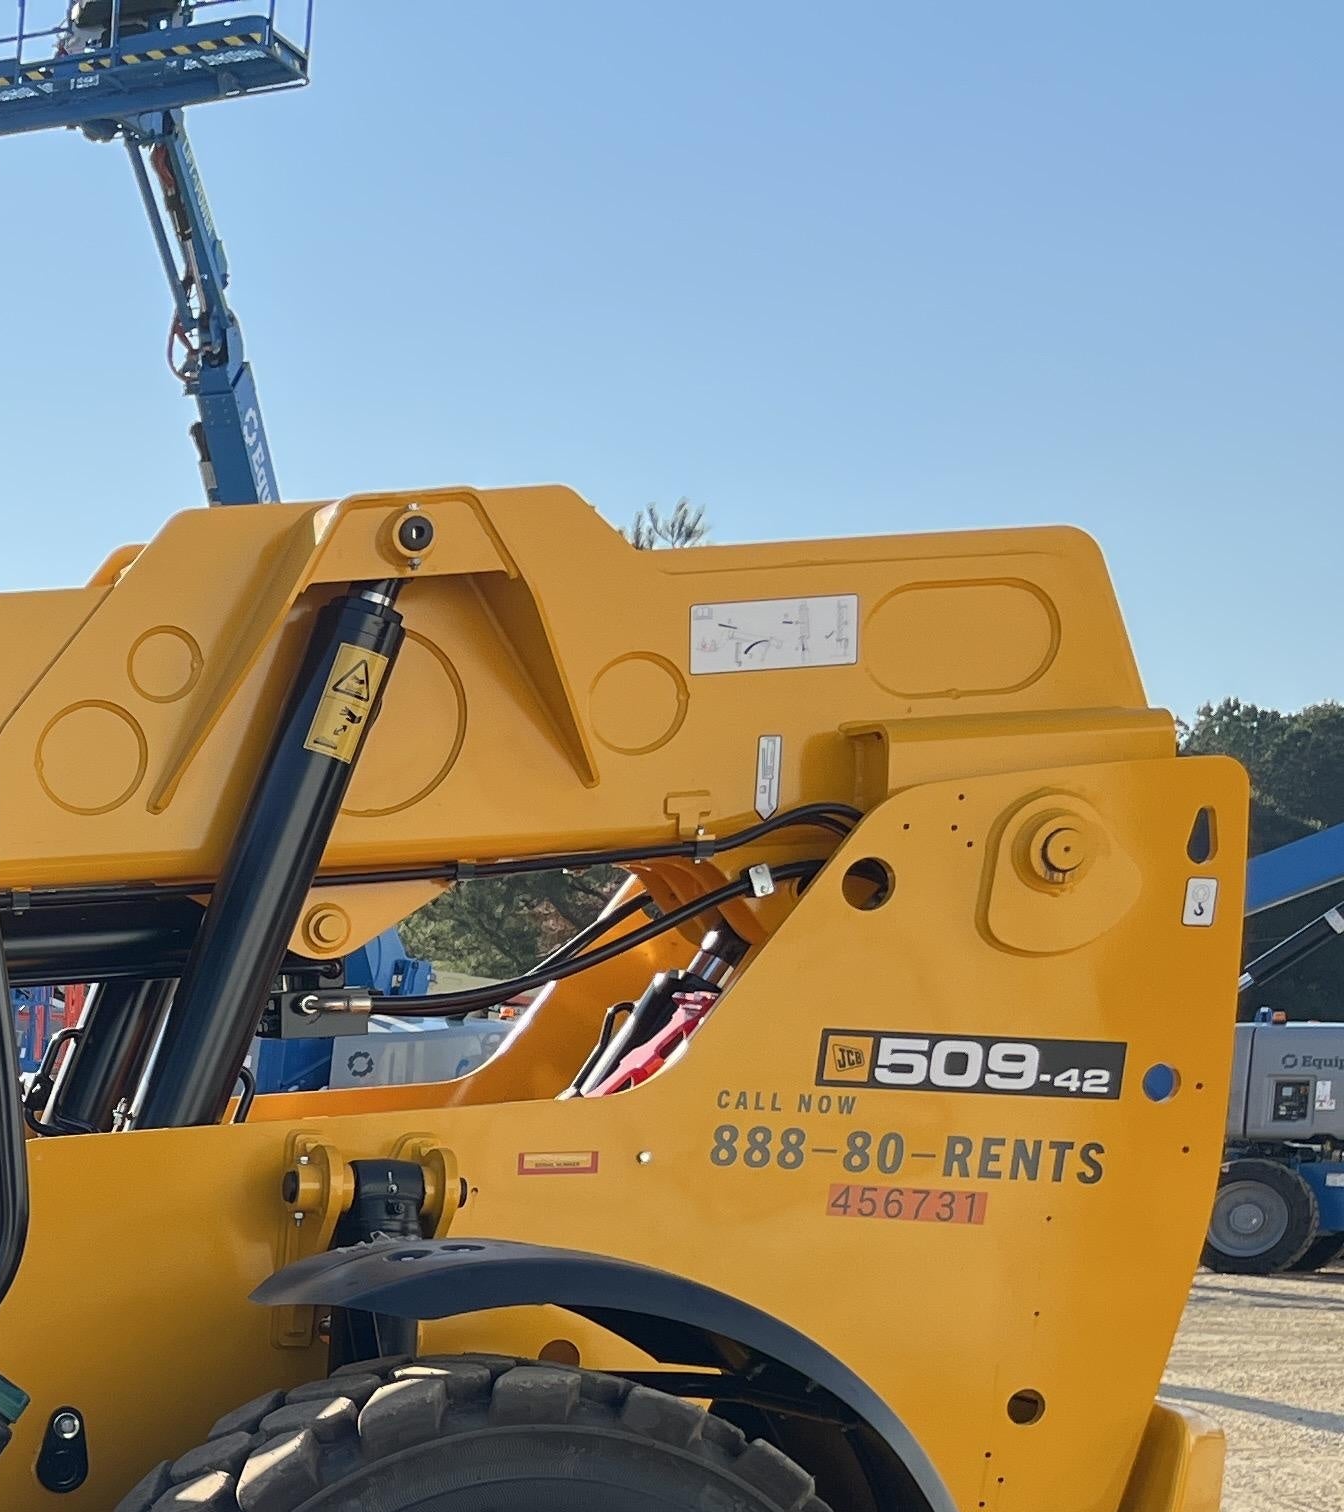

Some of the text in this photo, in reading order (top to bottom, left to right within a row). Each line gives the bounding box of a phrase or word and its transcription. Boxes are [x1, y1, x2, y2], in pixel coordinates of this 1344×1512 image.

[836, 1047, 863, 1069] JCB
[874, 1037, 1111, 1094] 509-42
[716, 1089, 857, 1116] CALL NOW
[709, 1123, 1106, 1185] 888-80-RENTS
[830, 1186, 978, 1224] 456731
